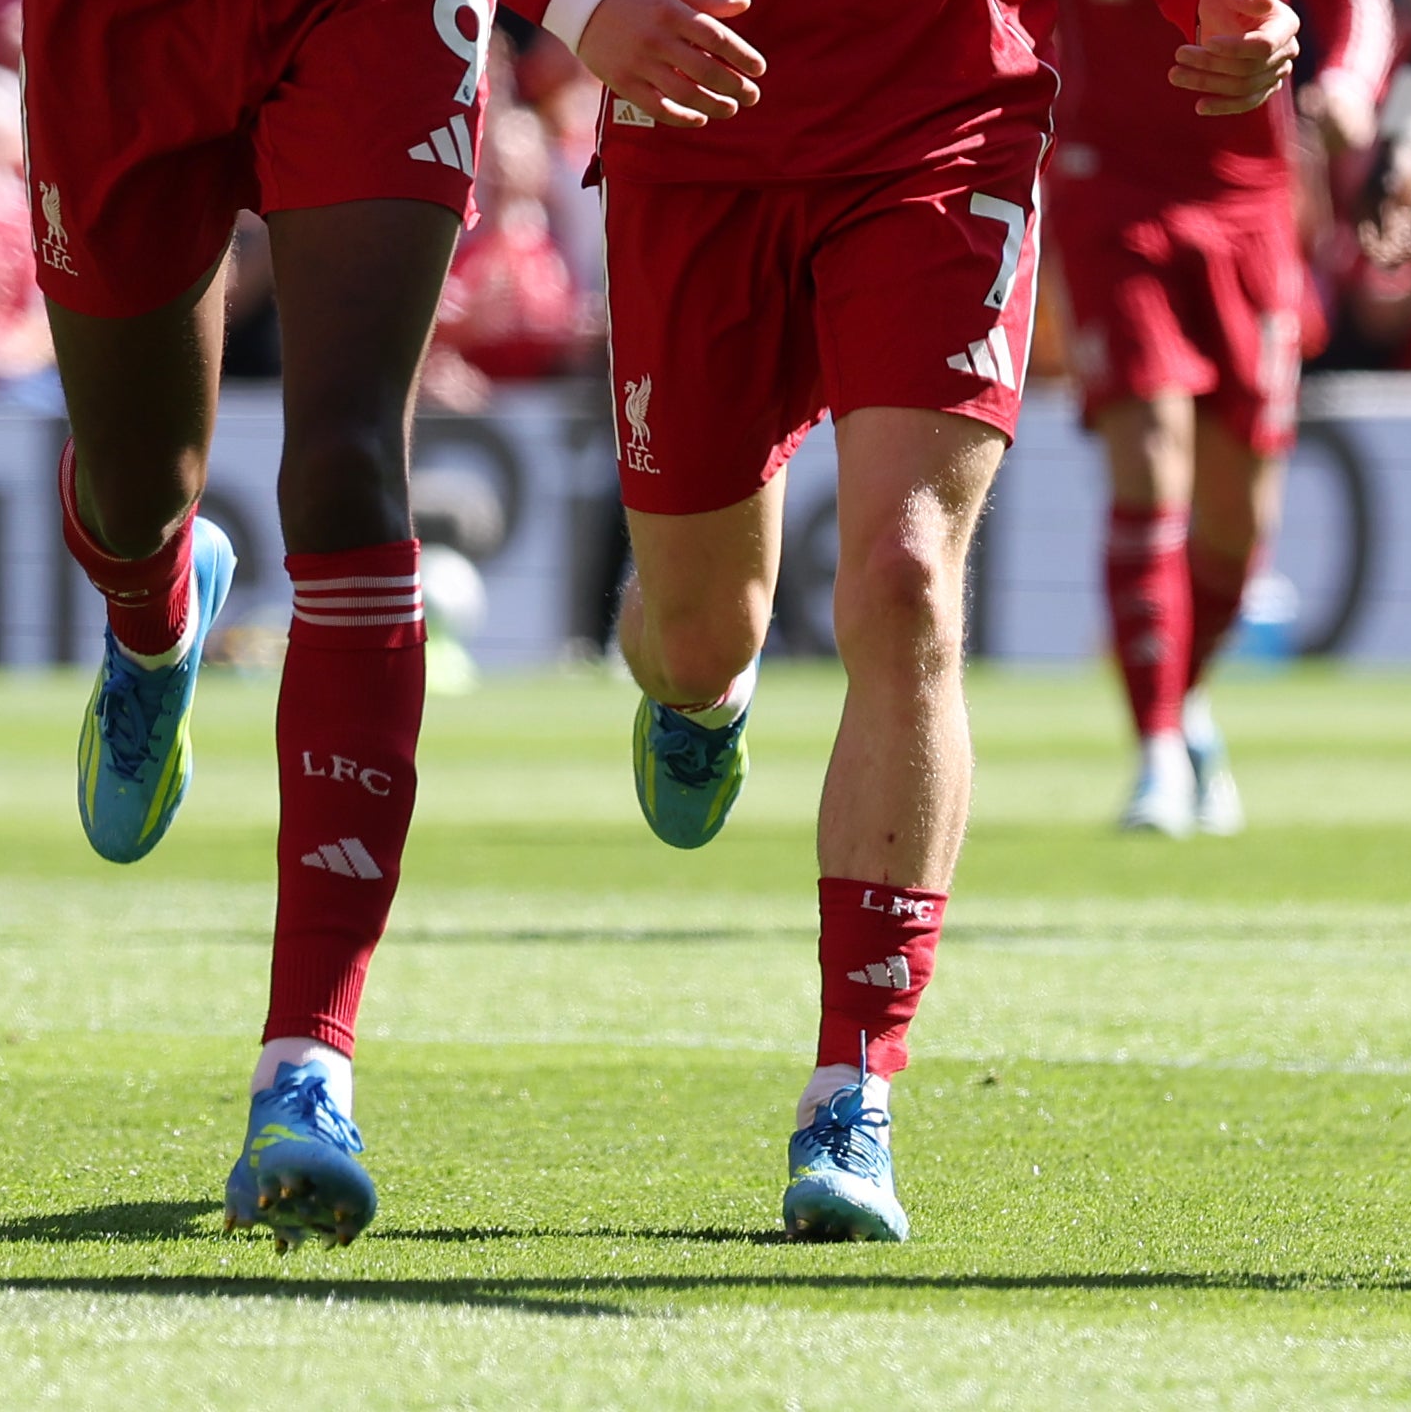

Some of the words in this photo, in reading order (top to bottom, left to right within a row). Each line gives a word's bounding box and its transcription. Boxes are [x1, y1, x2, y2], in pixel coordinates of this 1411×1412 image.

[42, 243, 78, 276] L.F.C.
[970, 192, 1026, 310] 7
[627, 448, 660, 474] L.F.C.
[302, 750, 392, 796] LFC
[860, 889, 934, 922] LFC
